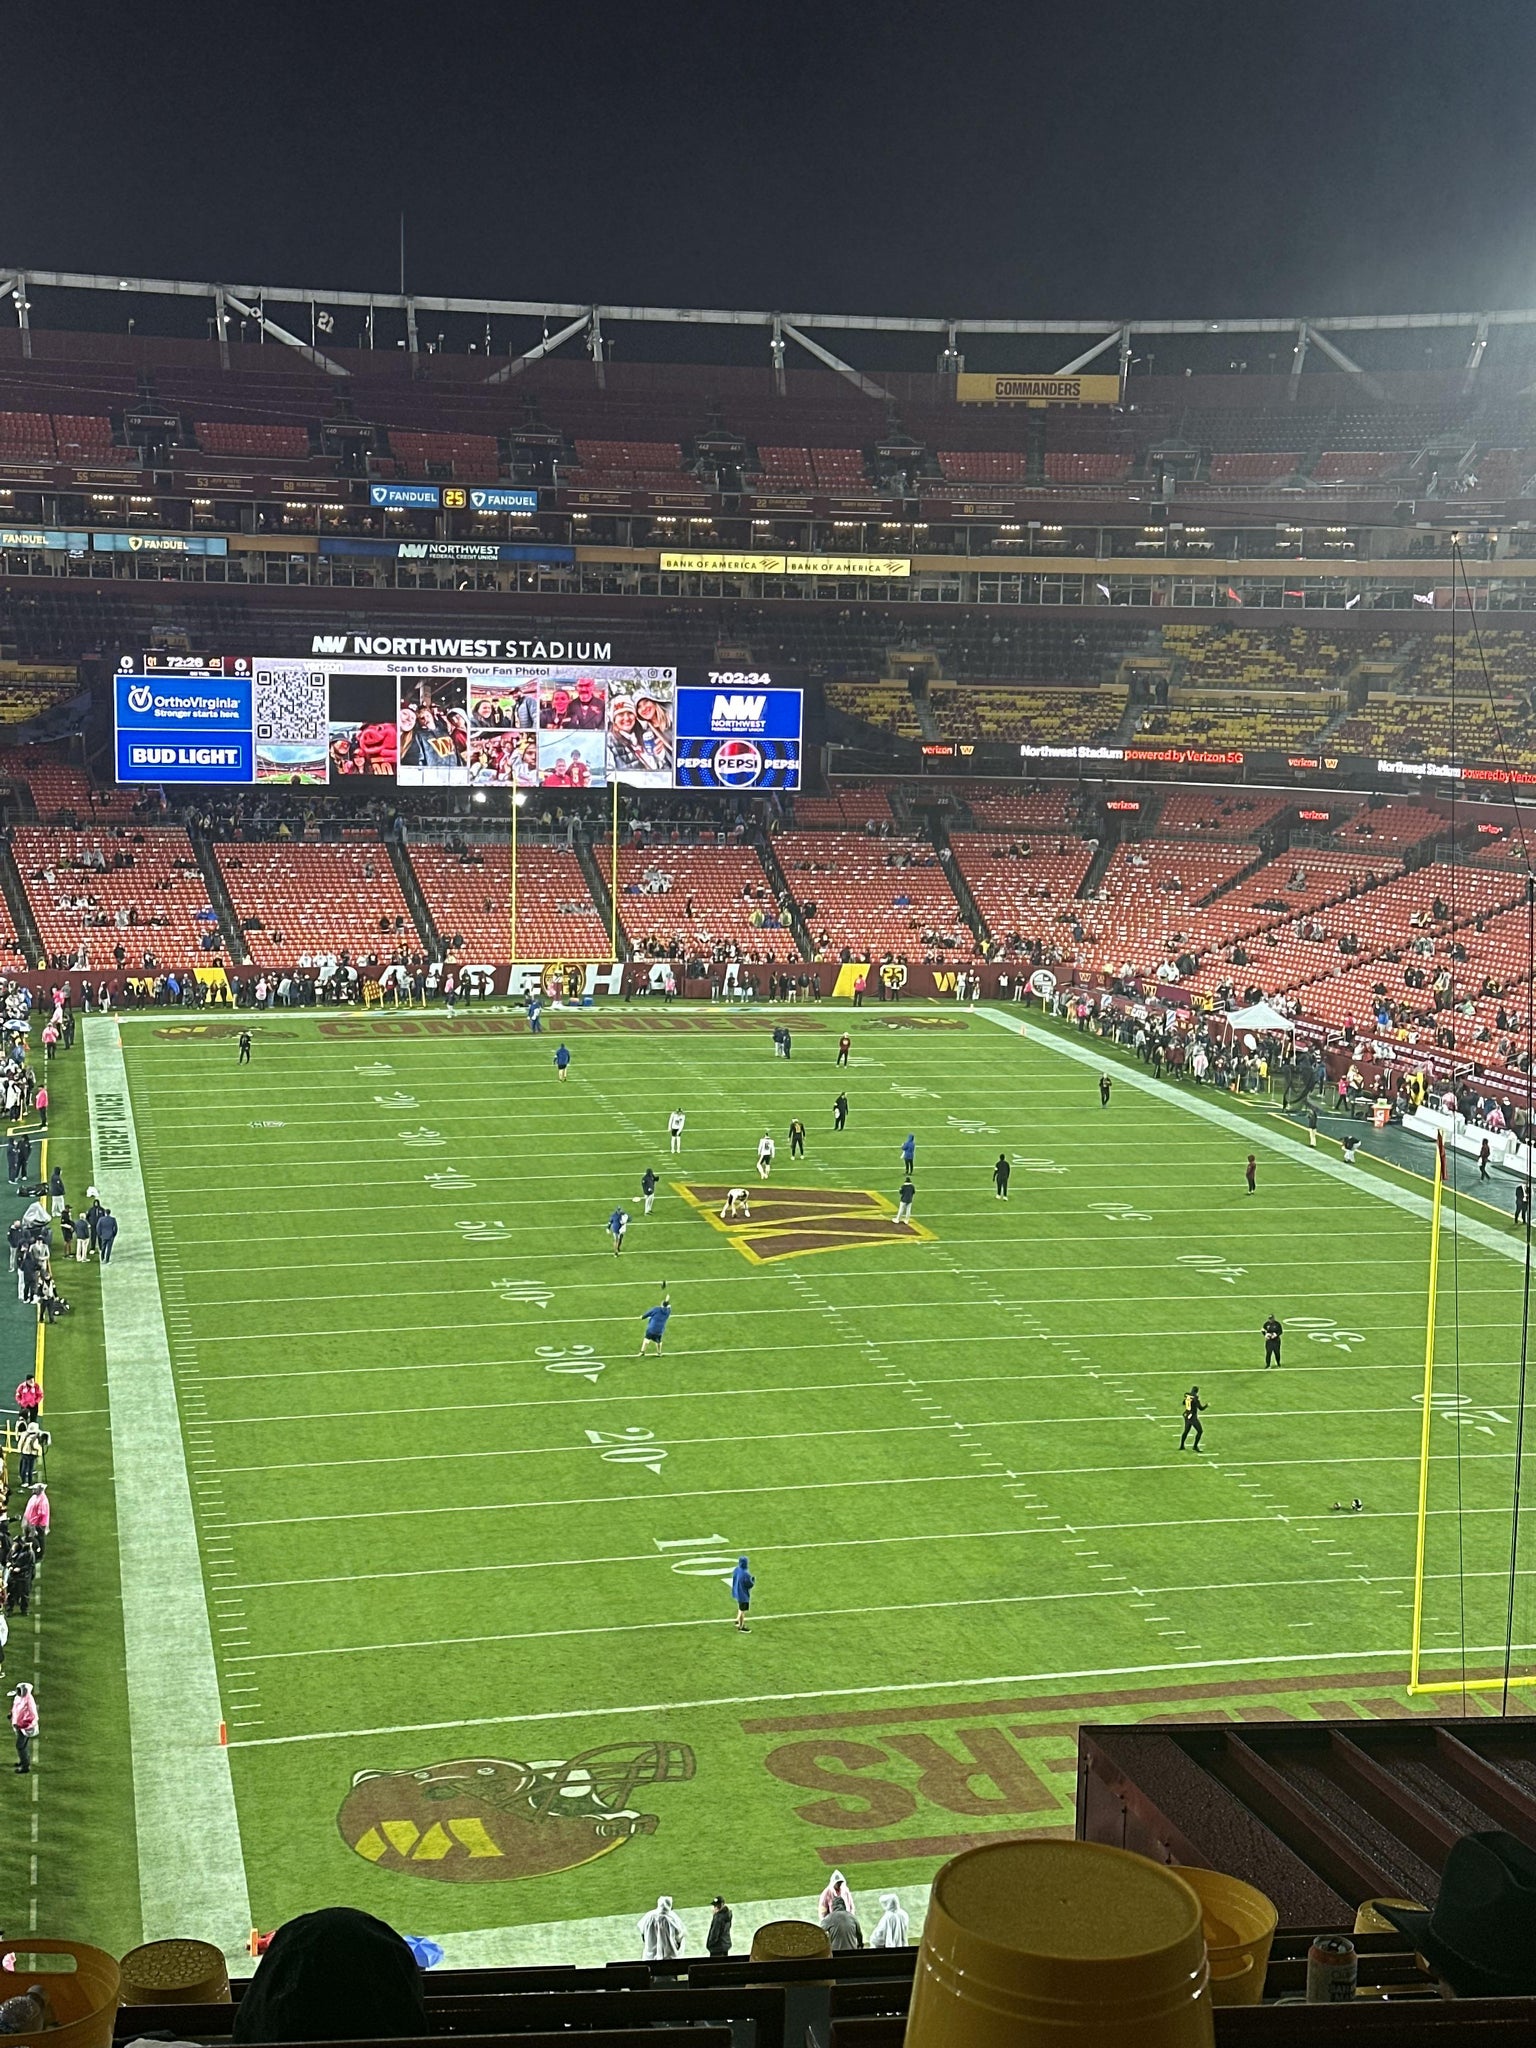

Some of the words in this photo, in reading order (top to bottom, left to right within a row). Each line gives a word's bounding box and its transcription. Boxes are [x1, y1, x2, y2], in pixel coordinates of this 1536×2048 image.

[995, 382, 1081, 396] COMMANDERS
[389, 491, 438, 503] FANDUEL
[444, 491, 464, 506] 25
[487, 495, 536, 506] FANDUEL
[2, 534, 49, 545] FANDUEL
[144, 539, 190, 550] FANDUEL
[429, 544, 500, 556] NORTHWEST
[666, 560, 694, 568] BANK
[696, 560, 709, 568] OF
[711, 561, 757, 569] AMERICA
[791, 563, 818, 571] BANK
[821, 563, 834, 571] OF
[836, 564, 881, 572] AMERICA
[312, 635, 348, 653] NW
[354, 637, 501, 657] NORTHWEST
[506, 640, 611, 660] STADIUM
[120, 656, 133, 669] 0
[235, 659, 247, 671] 0
[387, 664, 414, 673] Scan
[417, 664, 427, 673] to
[431, 664, 463, 674] Share
[467, 666, 490, 675] Your
[493, 666, 513, 675] Fan
[708, 672, 771, 685] 7:02:34
[154, 696, 239, 710] OrthoVirginia
[712, 694, 767, 720] NW
[154, 709, 191, 718] Stronger
[193, 710, 218, 718] starts
[711, 720, 766, 728] NORTHWEST
[921, 745, 953, 755] verizon
[1020, 745, 1078, 758] Northwest
[1078, 746, 1123, 759] Stadium
[1124, 749, 1171, 763] powered
[1172, 750, 1186, 763] by
[1186, 751, 1226, 763] Verizon
[1226, 752, 1244, 764] 5G
[132, 748, 176, 764] BUD
[178, 748, 238, 765] LIGHT
[677, 758, 712, 769] PEPSI
[718, 758, 758, 769] PEPSI
[764, 759, 799, 770] PEPSI
[1288, 758, 1318, 768] verizon
[1378, 760, 1427, 774] Northwest
[1461, 768, 1498, 781] powered
[1499, 769, 1511, 784] by
[1107, 800, 1139, 810] verizon
[1299, 810, 1329, 820] verizon
[317, 1015, 828, 1036] COMMANDERS
[95, 1093, 126, 1121] CANCER
[97, 1125, 133, 1170] INTERCEPT
